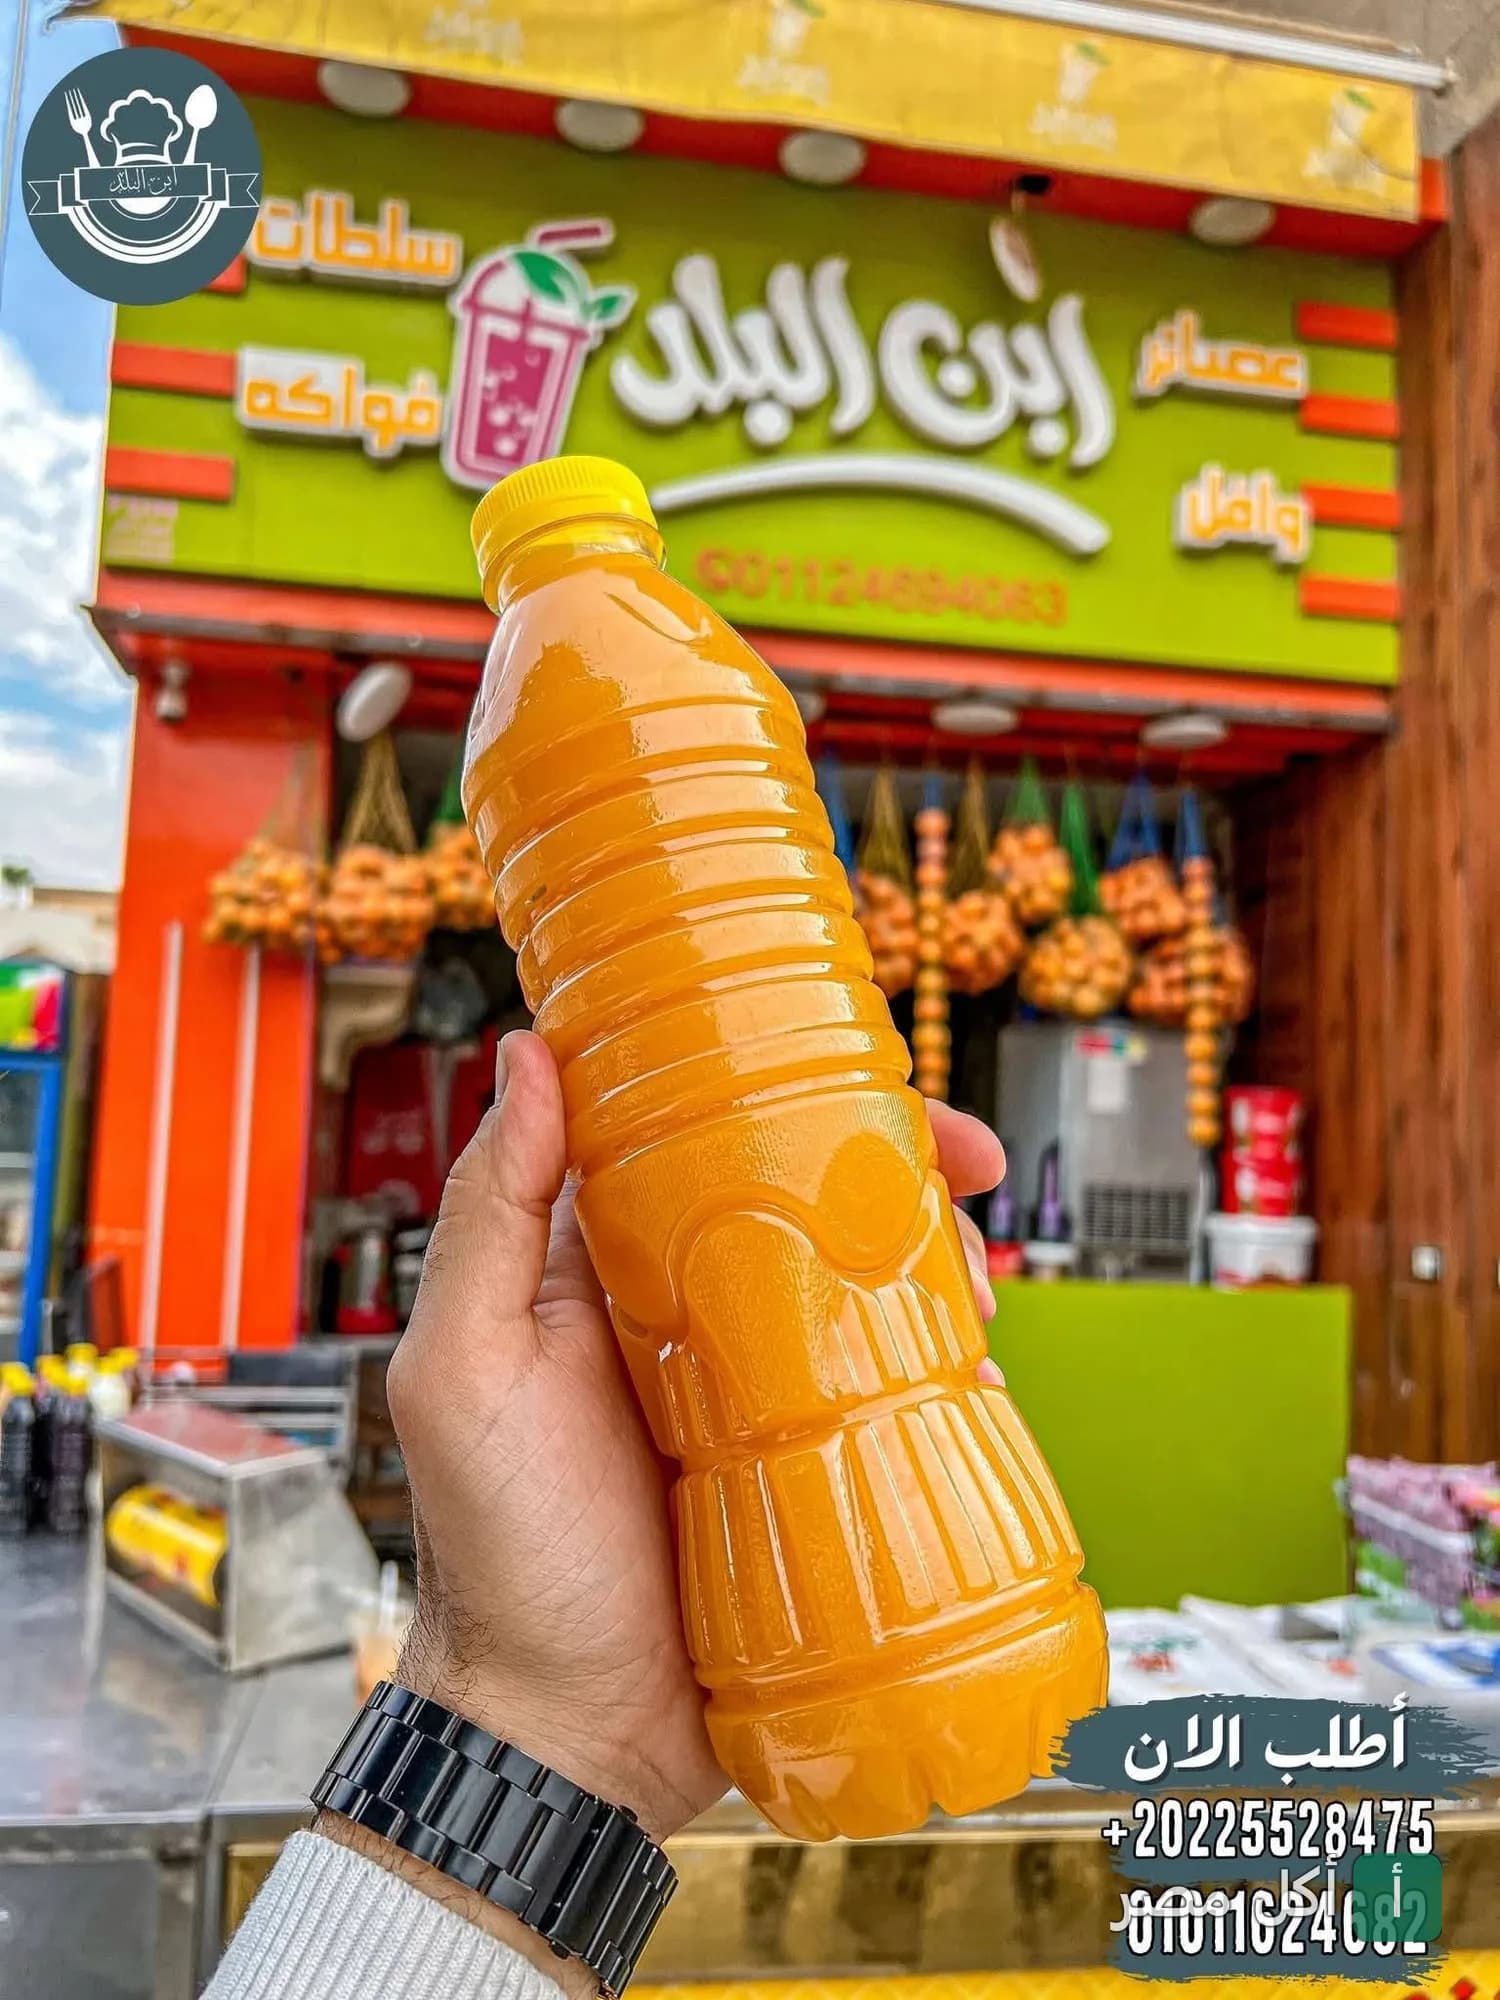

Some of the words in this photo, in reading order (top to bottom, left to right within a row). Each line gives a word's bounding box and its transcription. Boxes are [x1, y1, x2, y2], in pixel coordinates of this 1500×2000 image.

[253, 192, 458, 281] سلطات
[610, 253, 873, 446] البلد
[878, 293, 1113, 467] ابن
[1141, 313, 1306, 396] عصائر
[241, 361, 443, 453] فواكه
[1181, 467, 1309, 559] وافل
